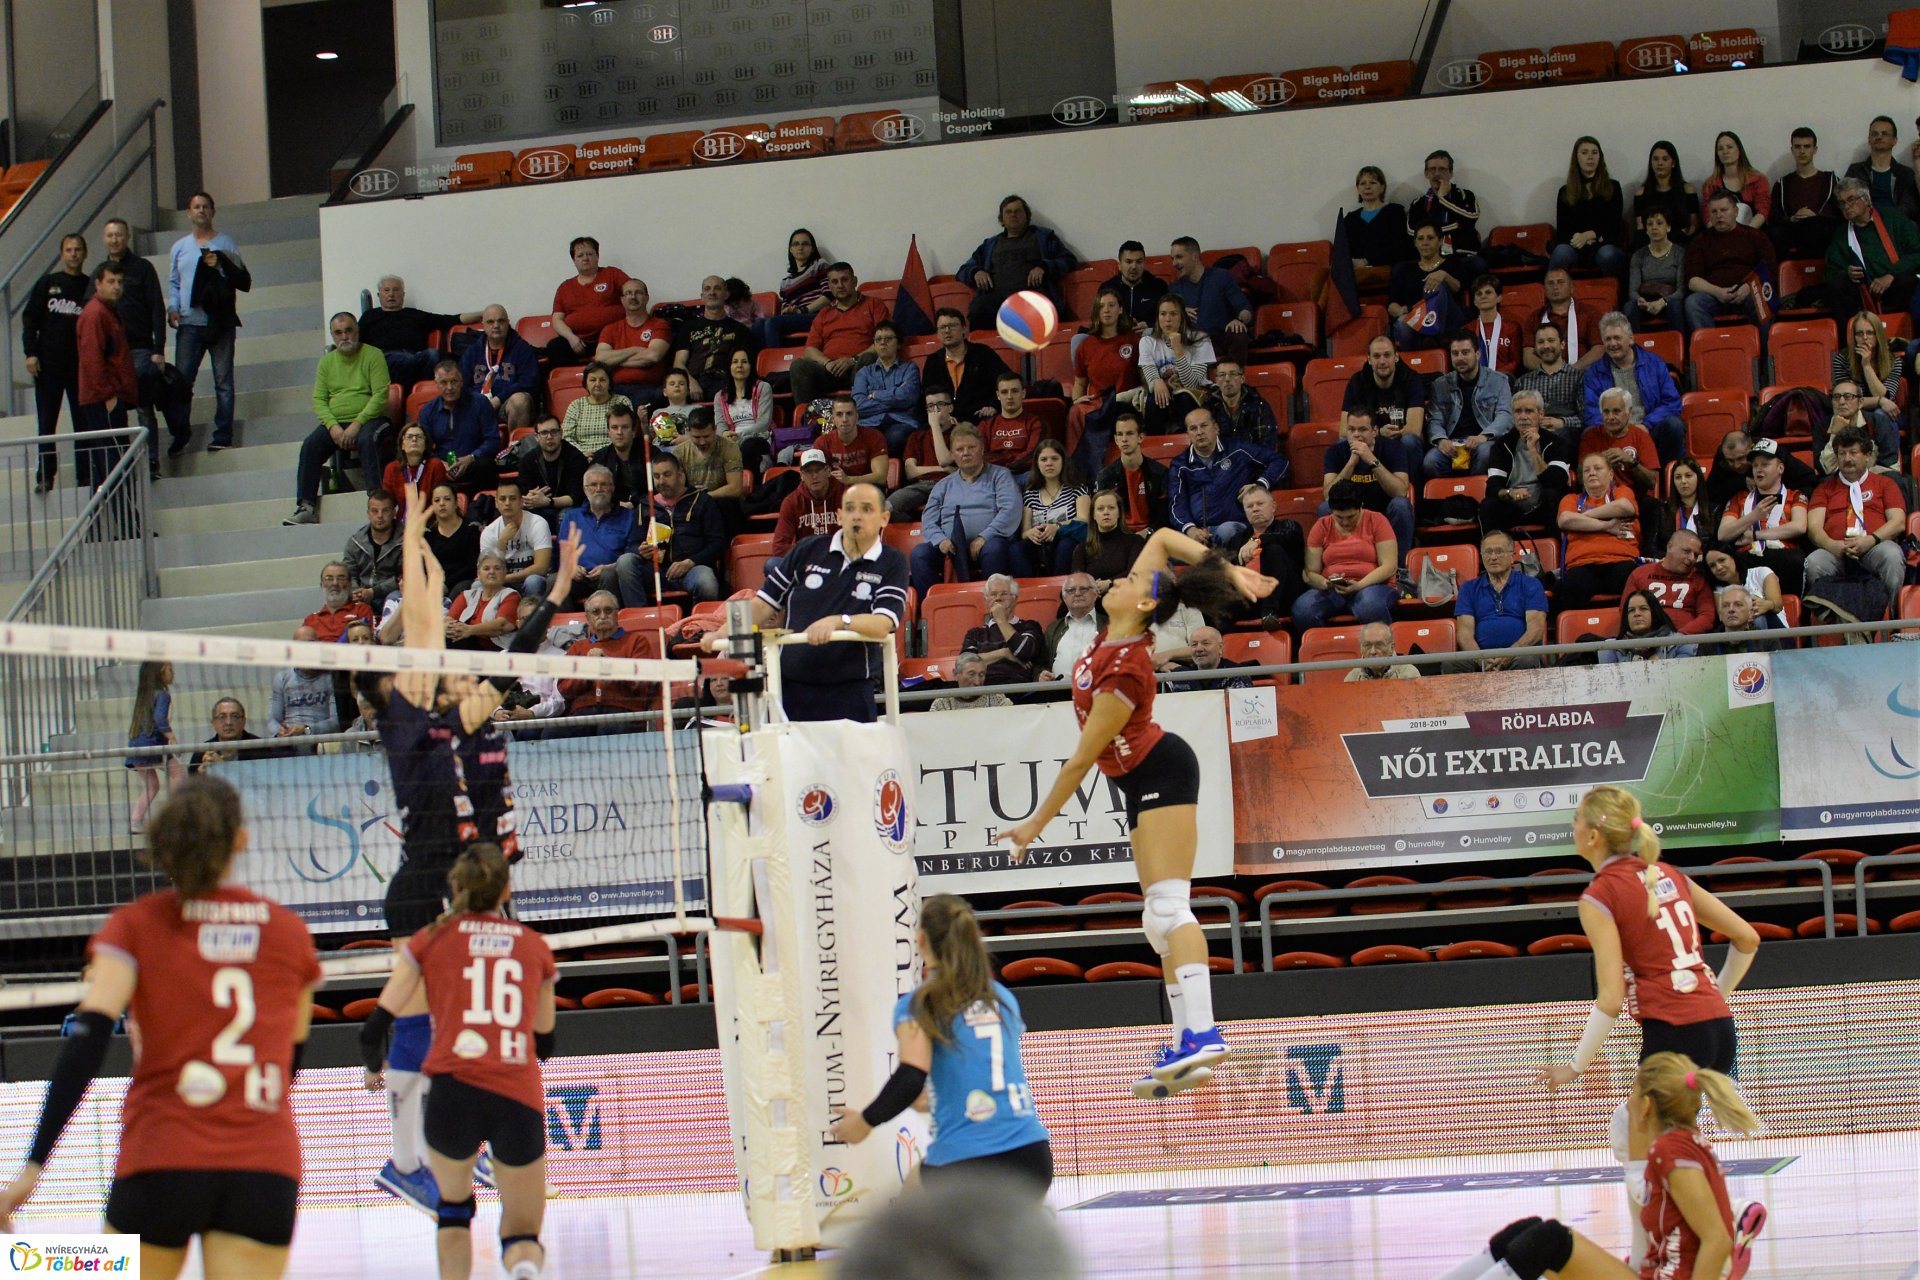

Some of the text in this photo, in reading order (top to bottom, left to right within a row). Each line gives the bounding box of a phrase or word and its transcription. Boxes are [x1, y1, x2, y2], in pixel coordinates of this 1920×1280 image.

[594, 12, 613, 24] BH
[653, 27, 673, 41] BH
[1828, 28, 1865, 49] BH
[1690, 34, 1767, 52] Bige Holding
[854, 54, 874, 68] BH
[1499, 51, 1576, 69] Bige Holding
[1637, 46, 1673, 67] BH
[1705, 50, 1754, 64] Csoport
[558, 63, 577, 76] BH
[774, 62, 795, 75] BH
[814, 58, 834, 71] BH
[695, 70, 715, 83] BH
[734, 66, 754, 79] BH
[1302, 70, 1379, 86] Bige Holding
[1448, 64, 1482, 84] BH
[1514, 67, 1563, 81] Csoport
[1251, 82, 1286, 103] BH
[1318, 86, 1365, 99] Csoport
[931, 106, 1005, 123] Bige Holding
[1064, 101, 1096, 122] BH
[1128, 103, 1174, 116] Csoport
[780, 125, 823, 139] Holding
[883, 118, 915, 139] BH
[946, 121, 992, 135] Csoport
[576, 143, 645, 159] Bige Holding
[703, 136, 736, 158] BH
[765, 140, 811, 154] Csoport
[405, 161, 473, 177] Bige Holding
[528, 156, 560, 176] BH
[589, 158, 632, 171] Csoport
[360, 172, 390, 193] BH
[418, 176, 461, 189] Csoport
[1648, 582, 1690, 608] 27
[1409, 720, 1447, 728] 2018-2019
[1501, 711, 1595, 730] RÖPLABDA
[1380, 740, 1626, 780] NŐI EXTRALIGA
[917, 759, 1127, 827] TUM
[1141, 792, 1160, 802] JAKO
[1666, 820, 1737, 831] www.hunvolley.hu
[1408, 839, 1445, 848] hunvolley
[1473, 835, 1512, 844] Hunvolley
[1539, 832, 1567, 841] magyar
[1285, 842, 1386, 856] magyarroplabdaszovetseg
[601, 889, 665, 900] www.hunvolley.hu
[1655, 899, 1704, 971] 12
[462, 957, 523, 1028] 16
[212, 966, 256, 1066] 2
[973, 1022, 1006, 1092] 7
